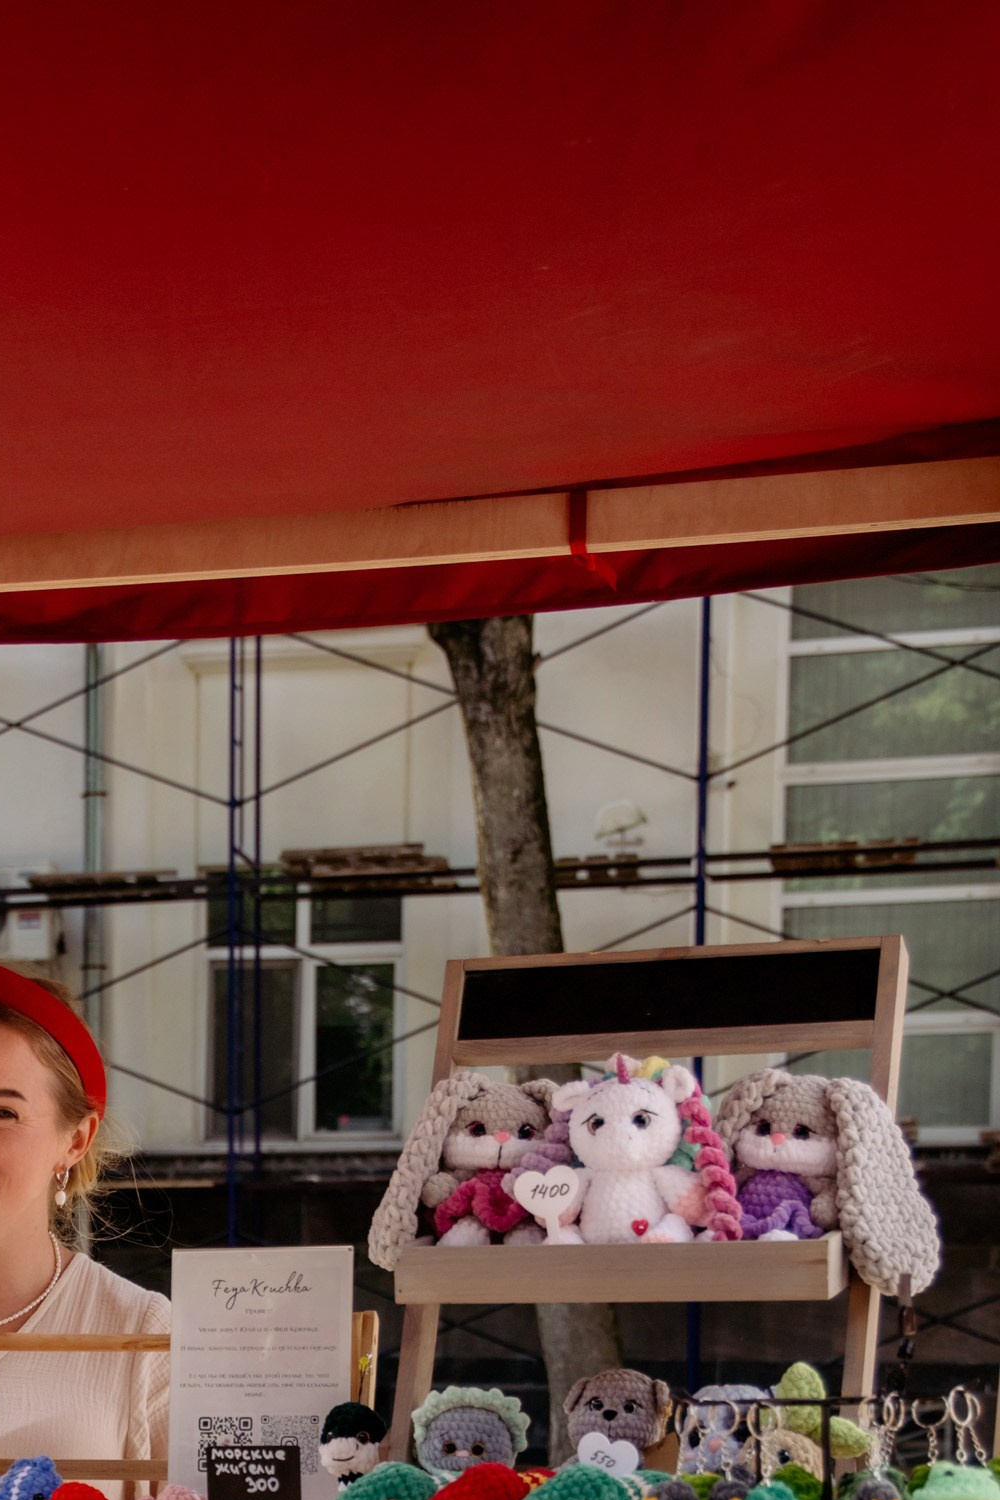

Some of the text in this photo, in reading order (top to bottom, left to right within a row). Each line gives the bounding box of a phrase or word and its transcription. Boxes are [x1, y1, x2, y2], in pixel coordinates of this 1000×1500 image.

[531, 1183, 570, 1199] 1400
[590, 1450, 616, 1468] 550
[245, 1476, 280, 1493] 300
